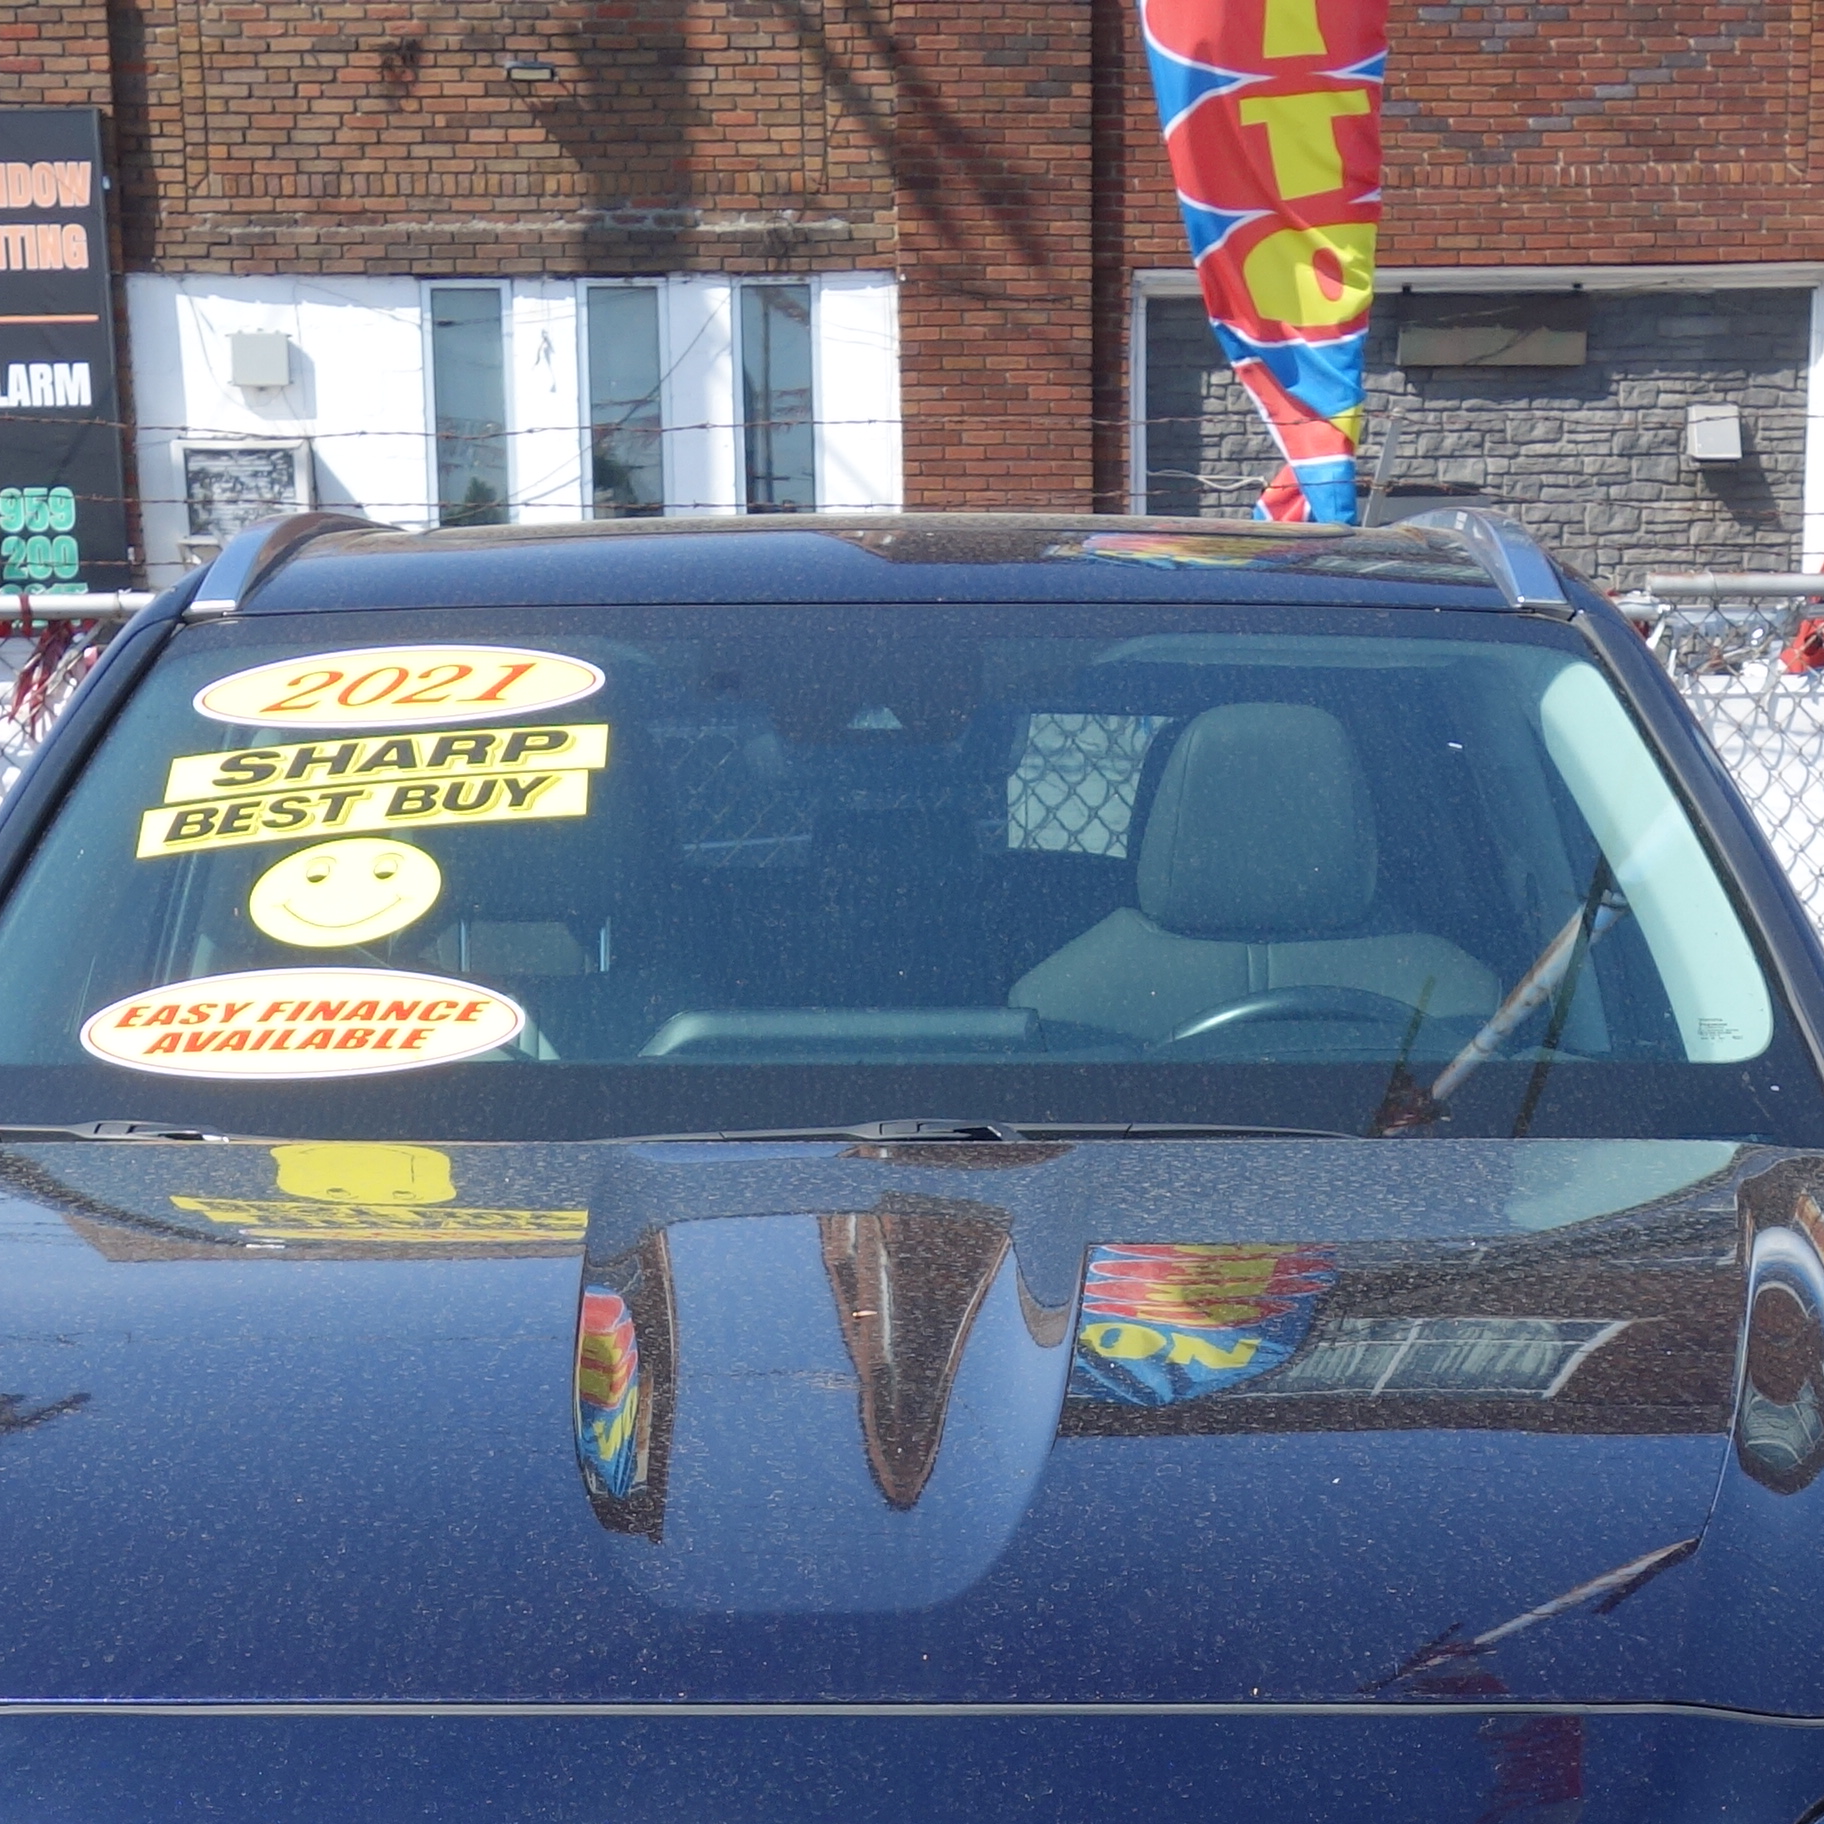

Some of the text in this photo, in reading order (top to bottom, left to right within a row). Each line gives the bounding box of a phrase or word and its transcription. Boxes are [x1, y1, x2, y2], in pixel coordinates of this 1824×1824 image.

[0, 534, 79, 580] 200
[258, 662, 537, 714] 2021
[211, 728, 572, 788] SHARP
[163, 775, 557, 844] BEST BUY
[113, 1000, 490, 1028] EASY FINANCE
[143, 1027, 436, 1055] AVAILABLE
